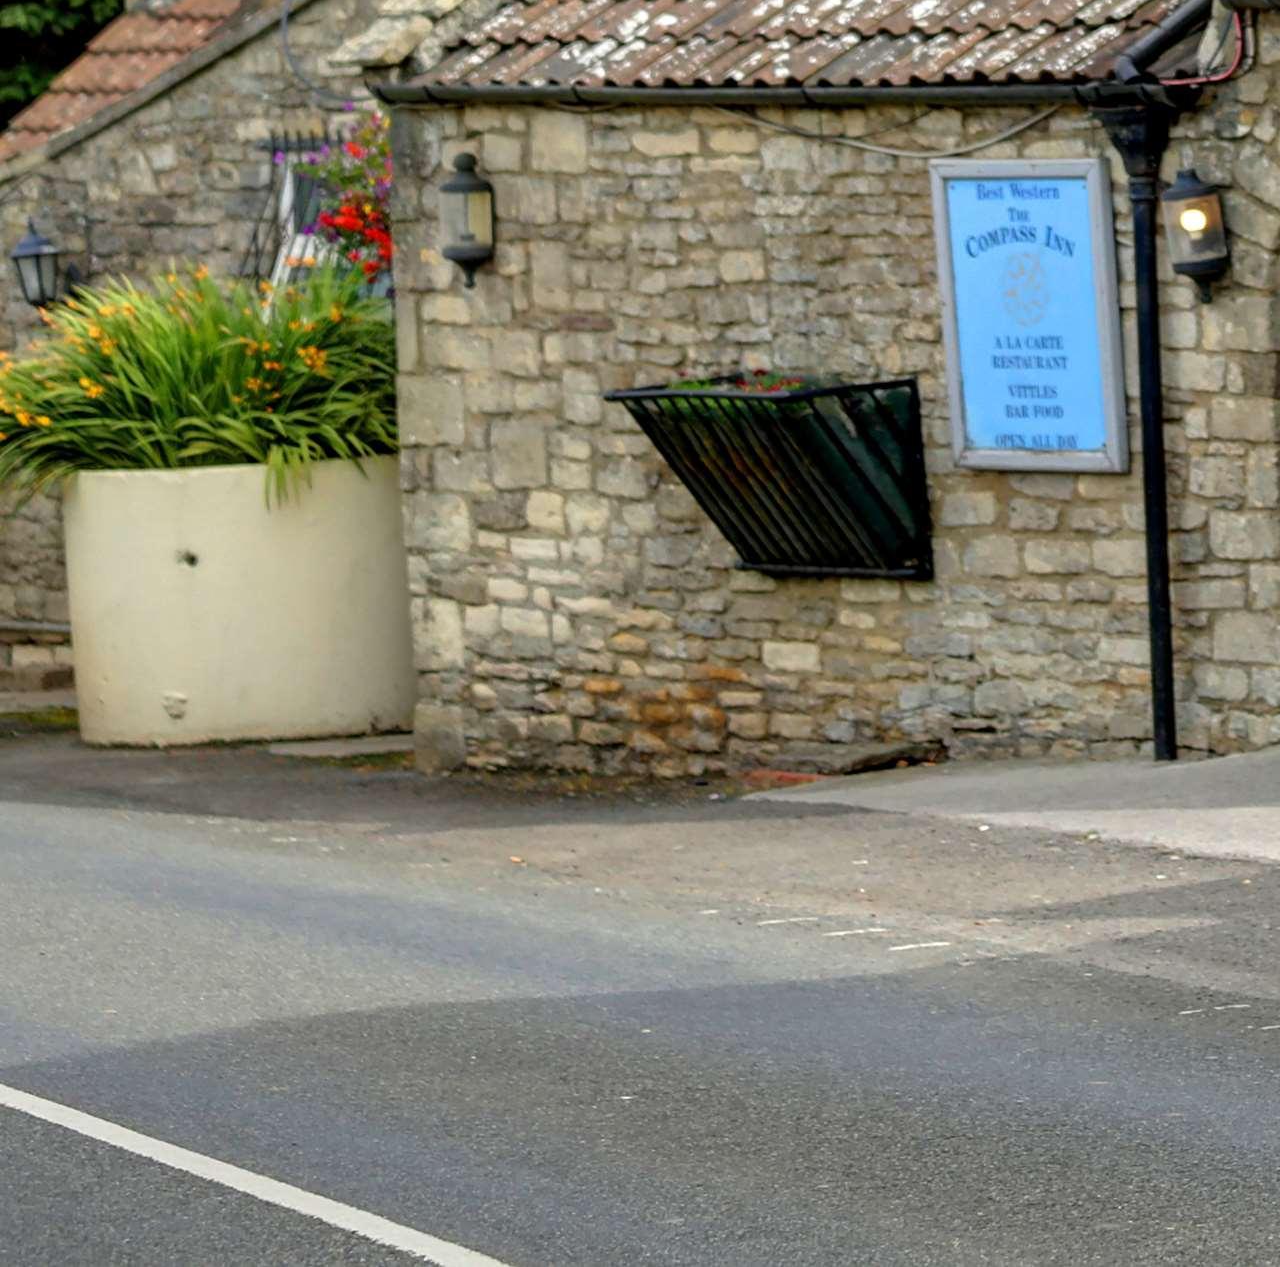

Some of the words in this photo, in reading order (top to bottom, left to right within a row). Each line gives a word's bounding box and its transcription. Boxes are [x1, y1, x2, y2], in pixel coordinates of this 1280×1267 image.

[976, 183, 1004, 200] Best
[1009, 183, 1060, 200] Western
[1006, 335, 1022, 350] LA
[1025, 335, 1064, 350] CARTE
[991, 355, 1067, 370] RESTAURANT
[1007, 384, 1058, 399] VITTLES
[1005, 404, 1029, 419] BAR
[1033, 405, 1064, 419] FOOD
[995, 434, 1026, 448] OPEN
[1031, 434, 1054, 448] ALL
[1057, 434, 1079, 449] DAY
